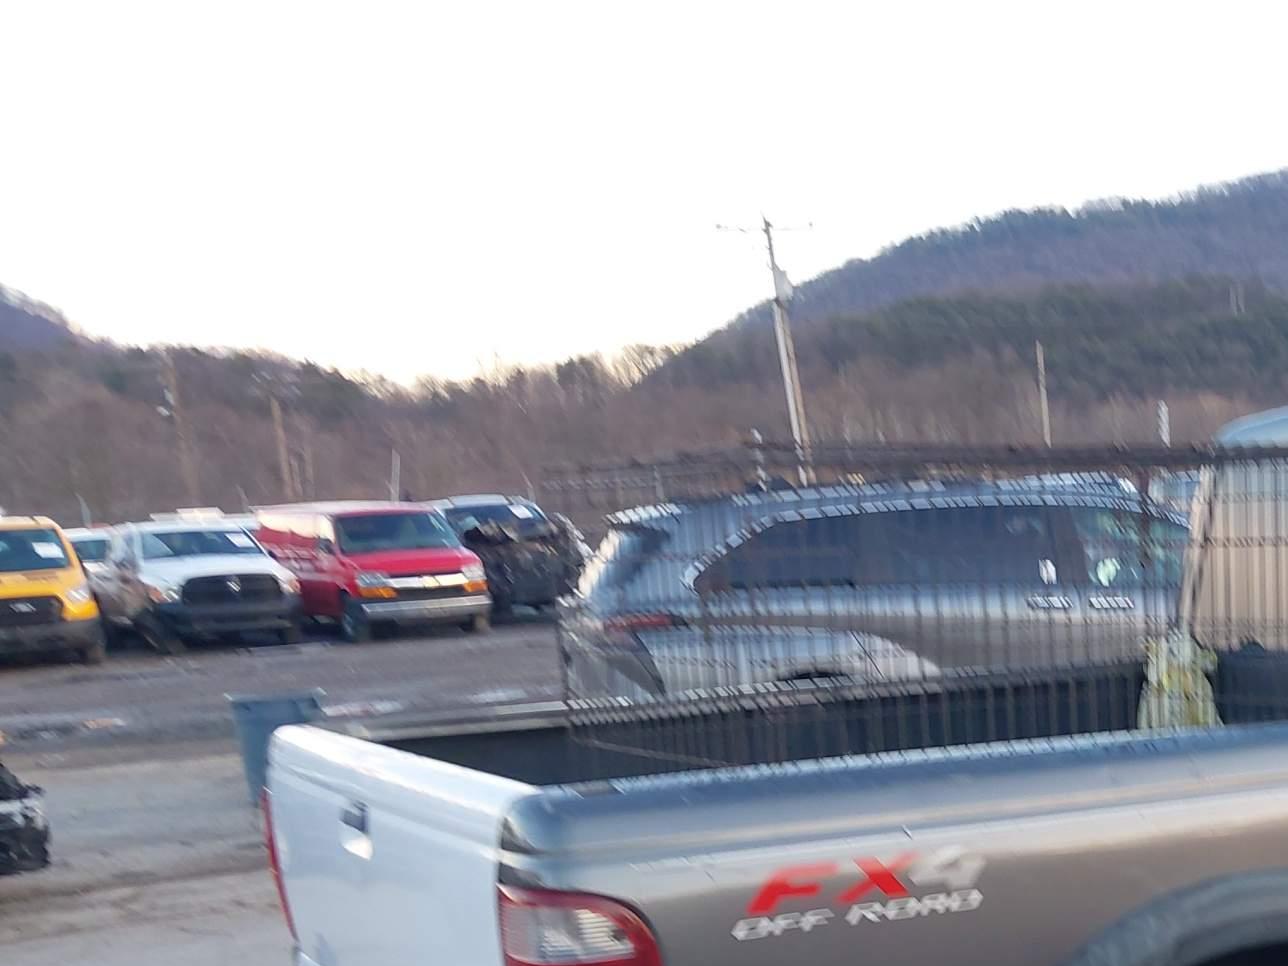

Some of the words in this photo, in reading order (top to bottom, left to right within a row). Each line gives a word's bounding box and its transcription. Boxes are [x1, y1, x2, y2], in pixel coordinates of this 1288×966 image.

[747, 845, 987, 917] FX4
[730, 908, 835, 941] OFF
[845, 889, 984, 926] ROAD
